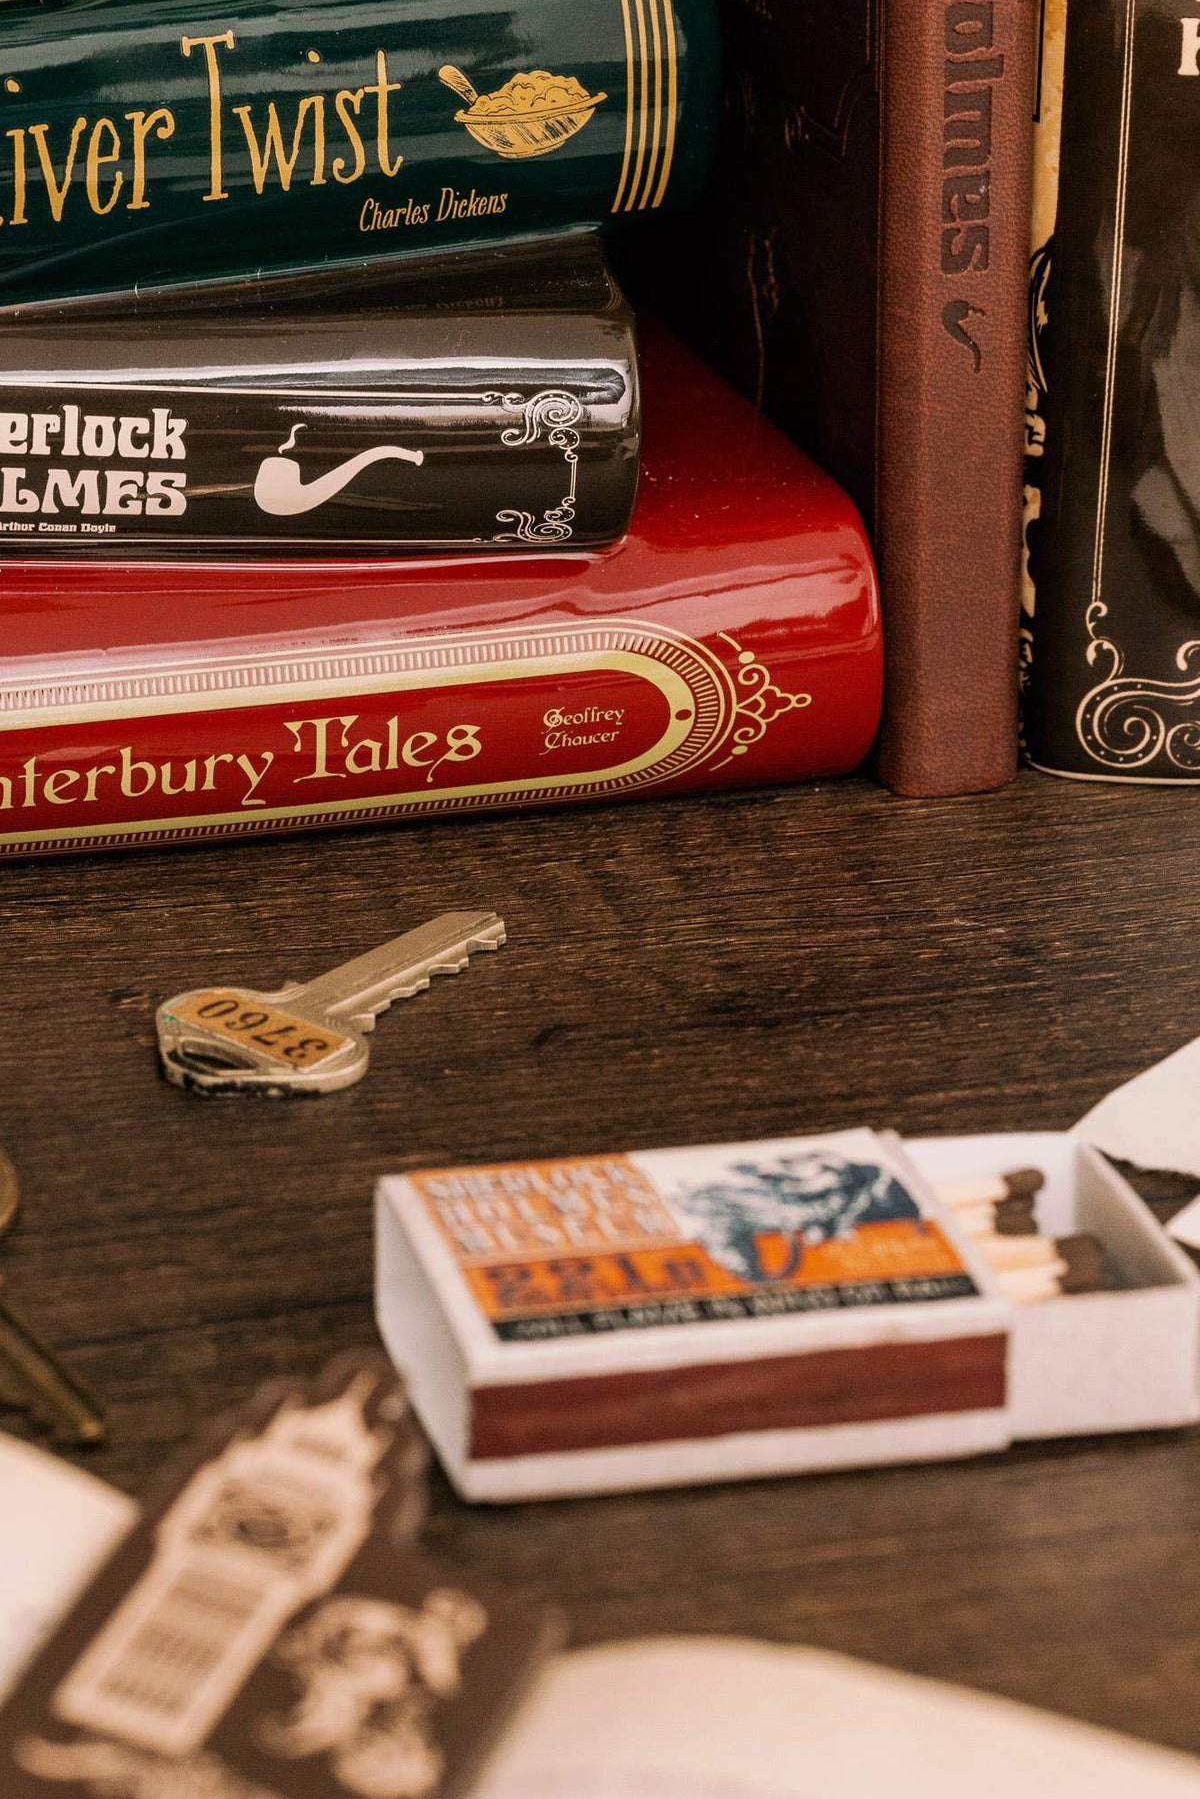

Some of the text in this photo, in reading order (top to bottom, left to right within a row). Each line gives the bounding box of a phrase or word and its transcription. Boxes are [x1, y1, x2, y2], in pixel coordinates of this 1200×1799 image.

[181, 30, 404, 201] Twist
[359, 187, 509, 232] Charles Dickens
[38, 522, 78, 533] Conan
[80, 522, 117, 534] Doyle
[542, 706, 625, 733] Geoffrey
[283, 713, 482, 784] Tales
[539, 731, 620, 756] Chaucer
